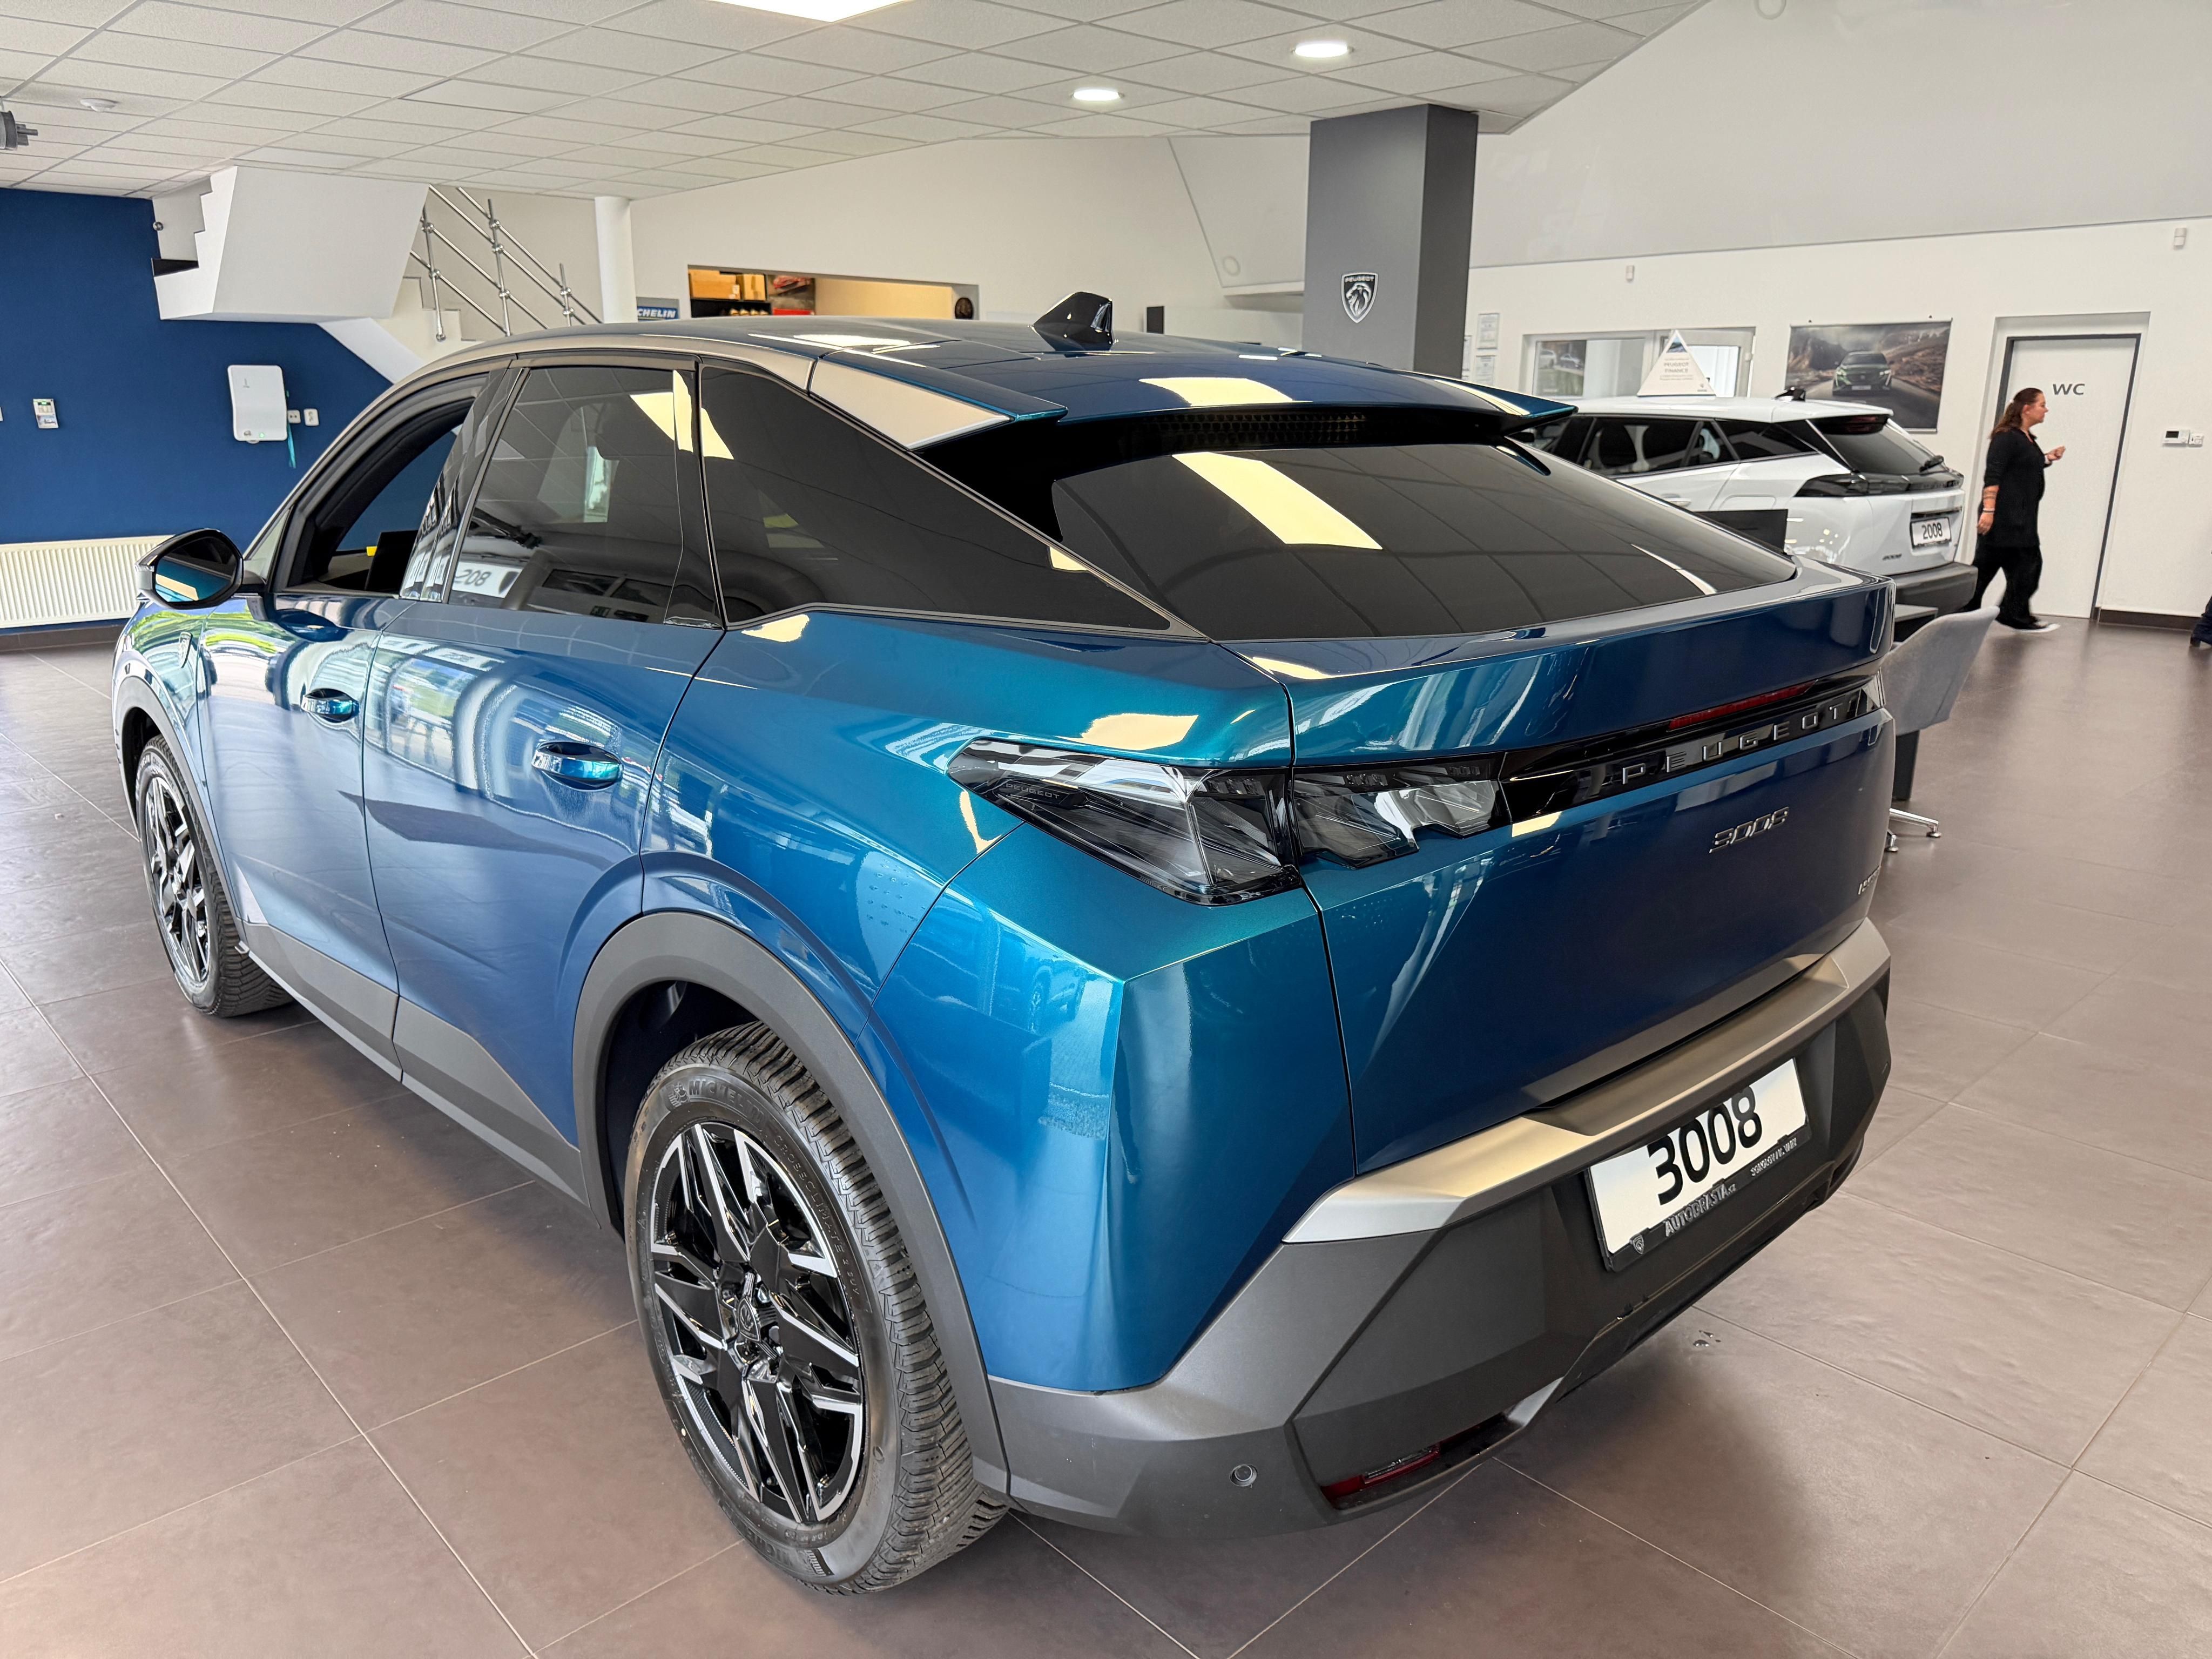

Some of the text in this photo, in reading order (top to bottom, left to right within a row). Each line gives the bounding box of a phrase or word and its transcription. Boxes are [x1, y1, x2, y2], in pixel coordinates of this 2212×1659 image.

[2053, 383, 2086, 395] WC
[1921, 522, 1943, 539] 2008
[1622, 703, 1843, 785] PEUGEOT
[1006, 783, 1060, 799] PEUGEOT
[1709, 806, 1789, 853] 3008
[689, 1079, 765, 1124] MICHELIN
[1647, 1085, 1763, 1206] 3008
